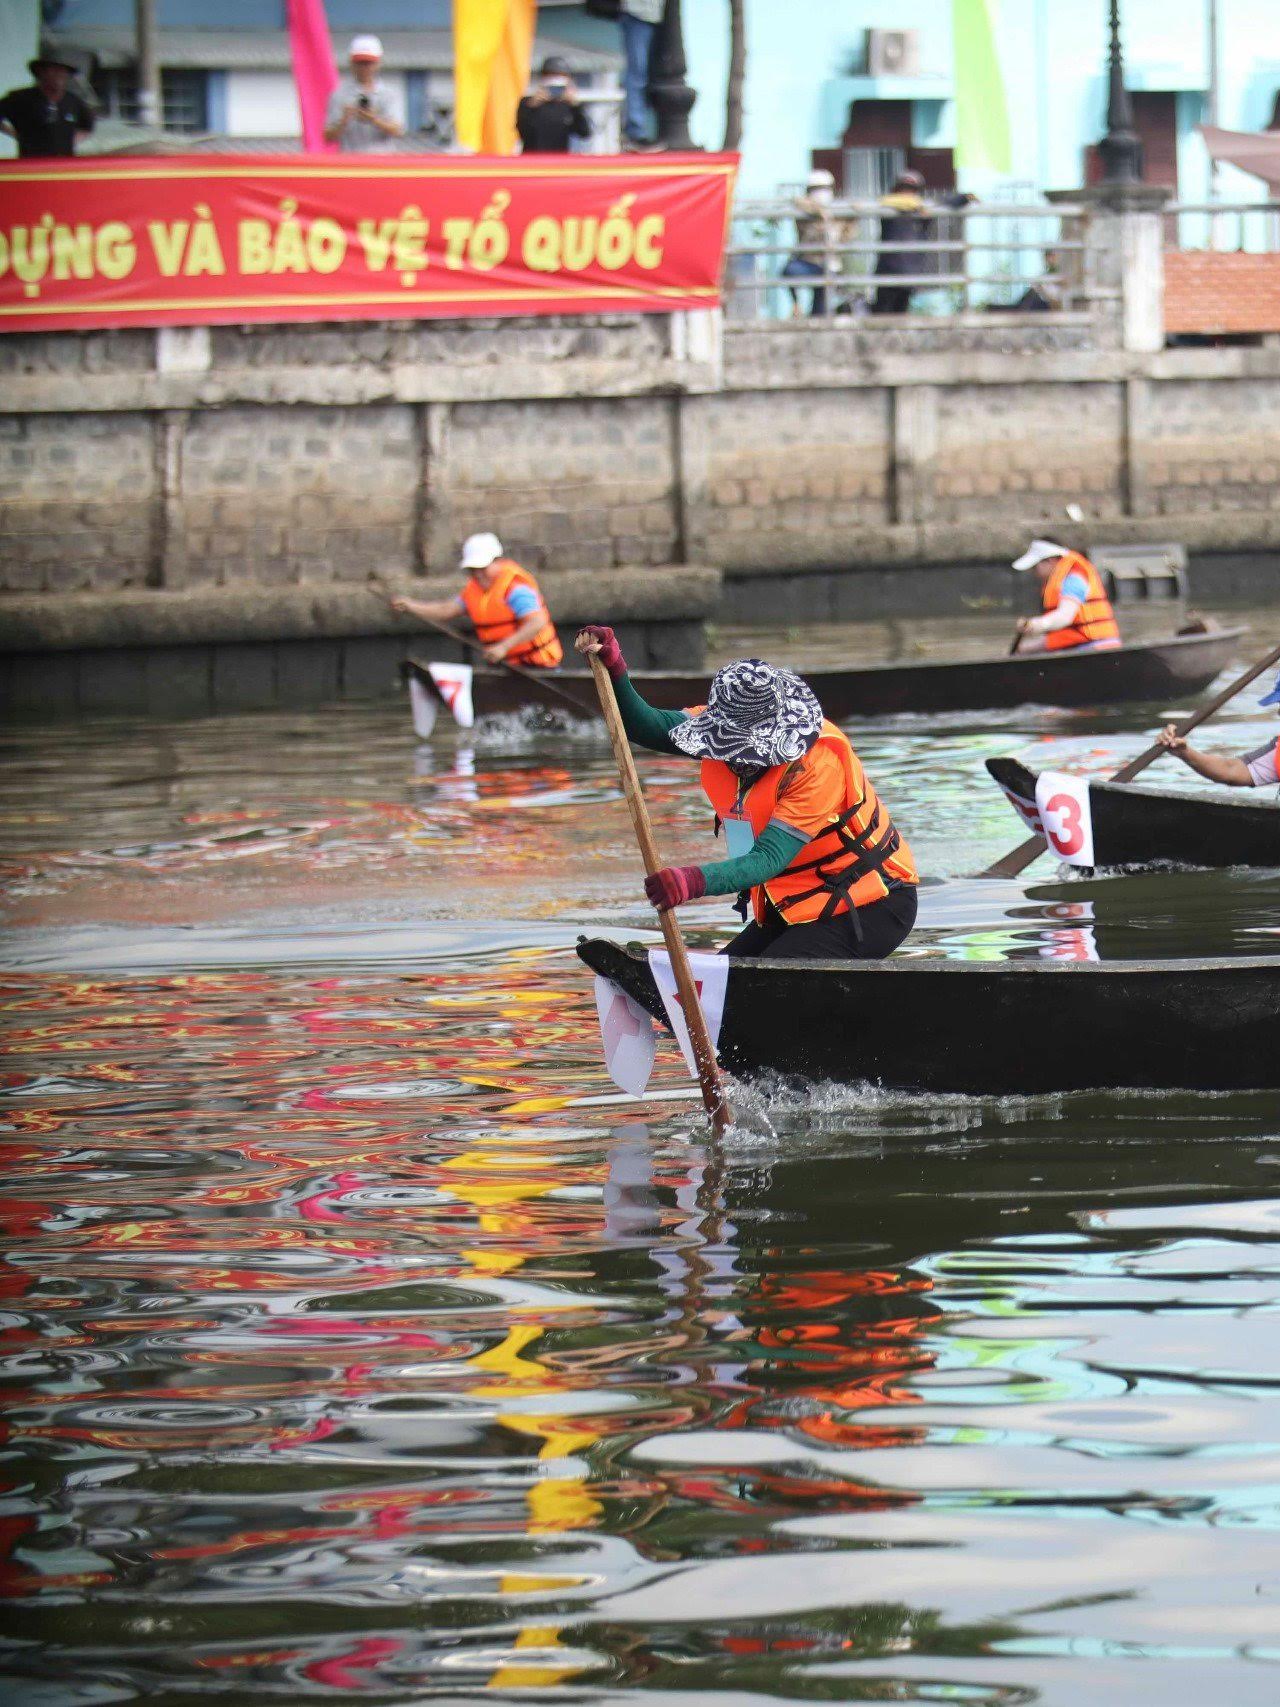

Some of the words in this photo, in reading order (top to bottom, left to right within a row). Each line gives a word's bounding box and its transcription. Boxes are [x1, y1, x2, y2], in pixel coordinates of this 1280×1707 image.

[0, 213, 136, 298] ỰNG
[148, 204, 226, 277] VÀ
[238, 197, 347, 274] BẢO
[357, 205, 429, 288] VỆ
[442, 189, 509, 271] TỔ
[522, 193, 665, 272] QUỐC
[1046, 793, 1084, 856] 3
